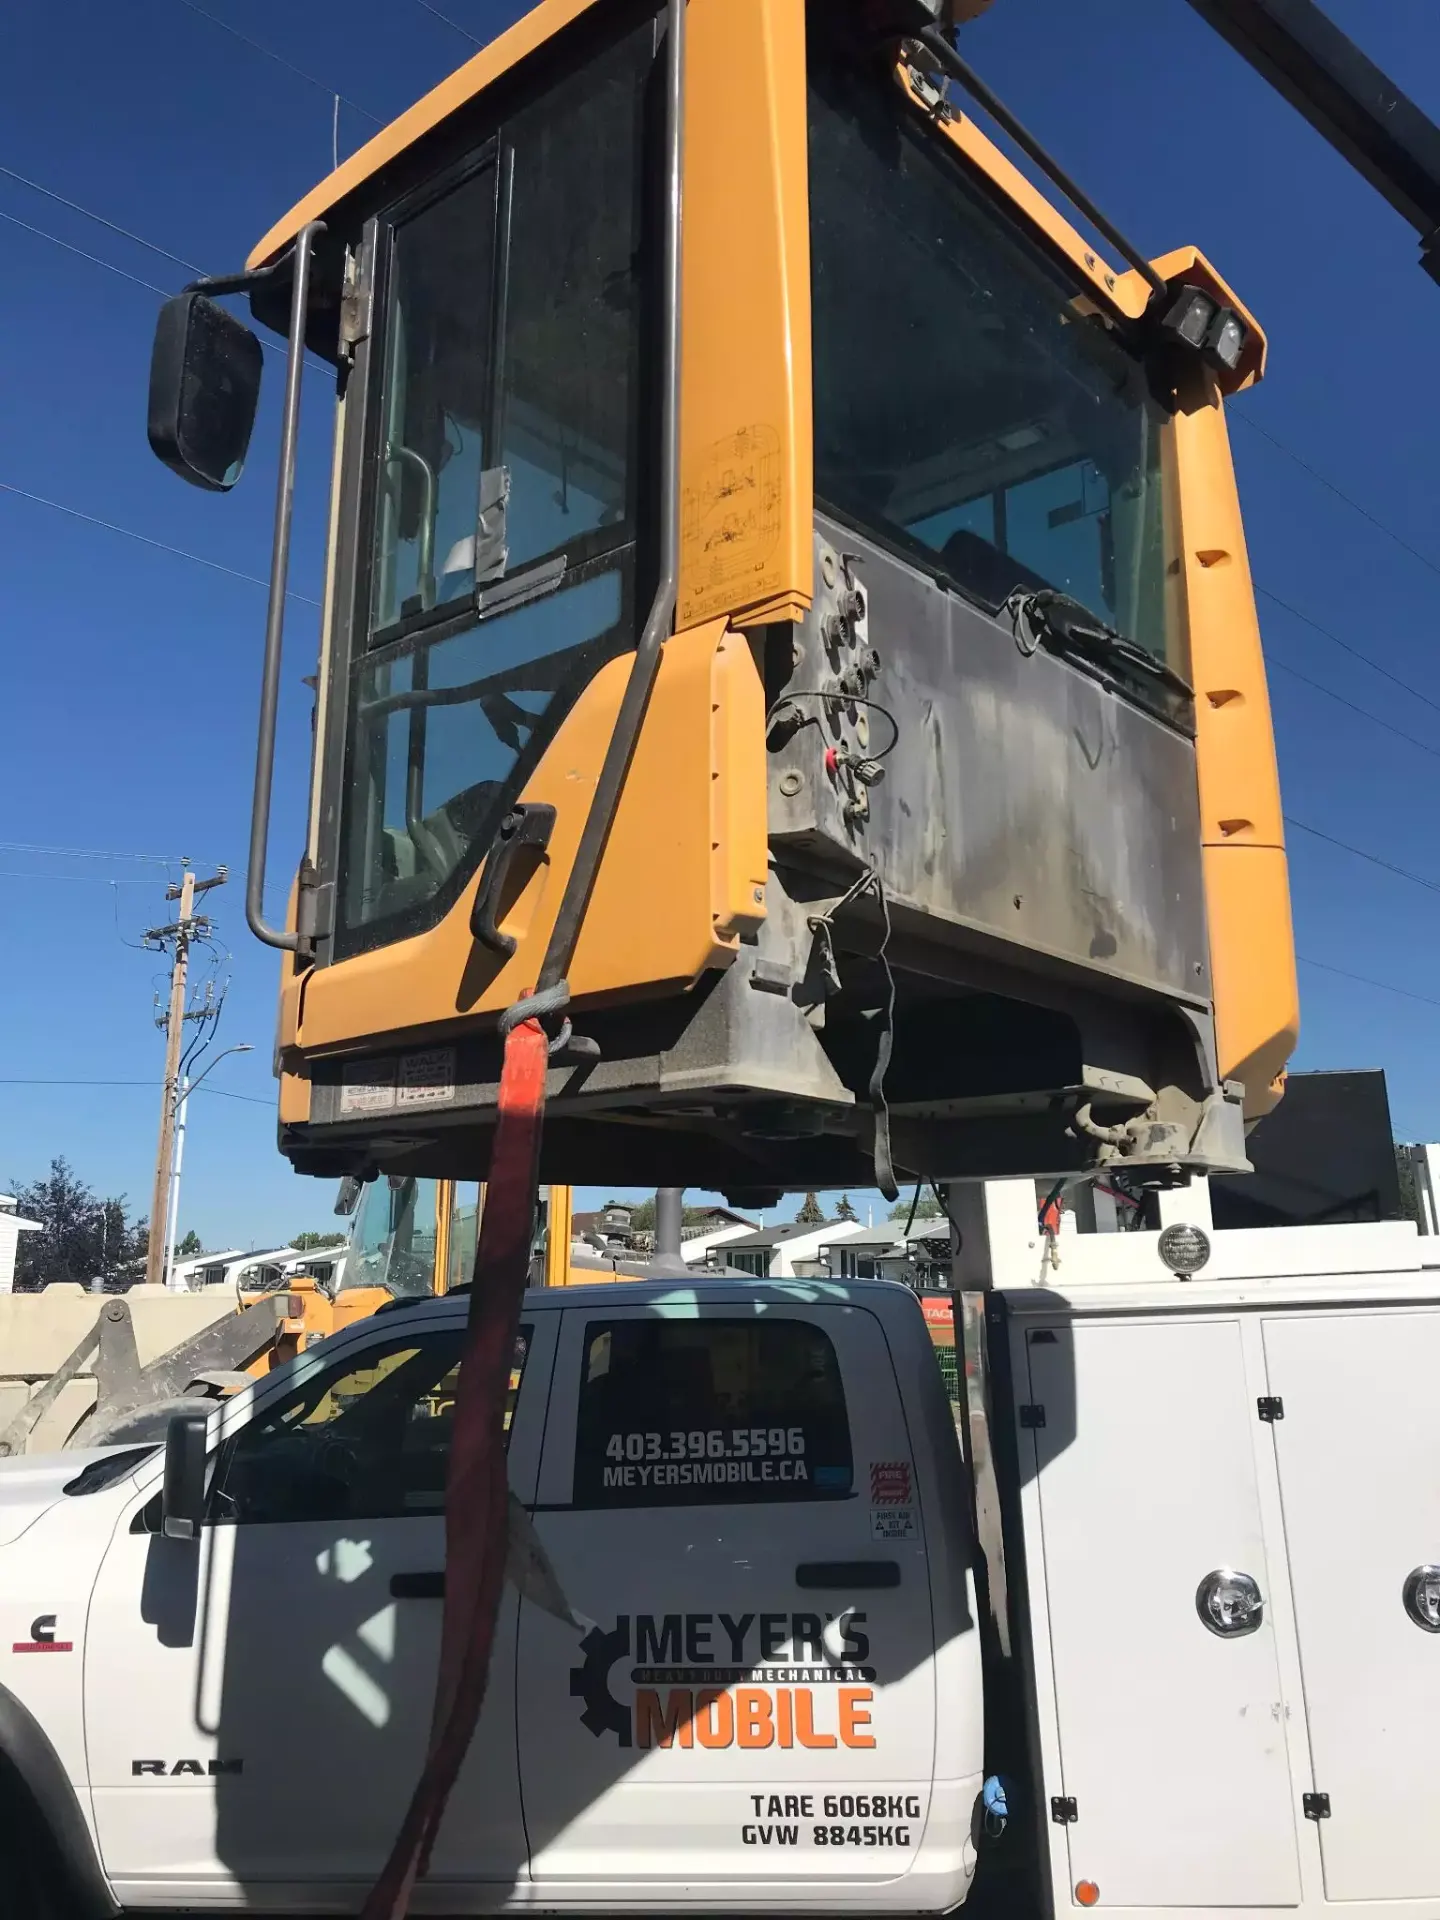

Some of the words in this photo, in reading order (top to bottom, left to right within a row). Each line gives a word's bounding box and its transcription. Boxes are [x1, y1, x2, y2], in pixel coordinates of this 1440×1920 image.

[606, 1428, 805, 1461] 403.396.5596
[603, 1460, 808, 1487] MEYERSMOBILE.CA
[878, 1470, 902, 1479] FIRE
[636, 1613, 870, 1664] MEYER'S
[642, 1669, 696, 1681] HEAVY
[752, 1669, 866, 1681] MECHANICAL
[636, 1688, 877, 1749] MOBILE
[131, 1759, 244, 1776] RAM
[751, 1795, 815, 1817] TARE
[824, 1795, 920, 1818] 6068KG
[742, 1825, 799, 1845] GVW
[813, 1825, 911, 1846] 8845KG
